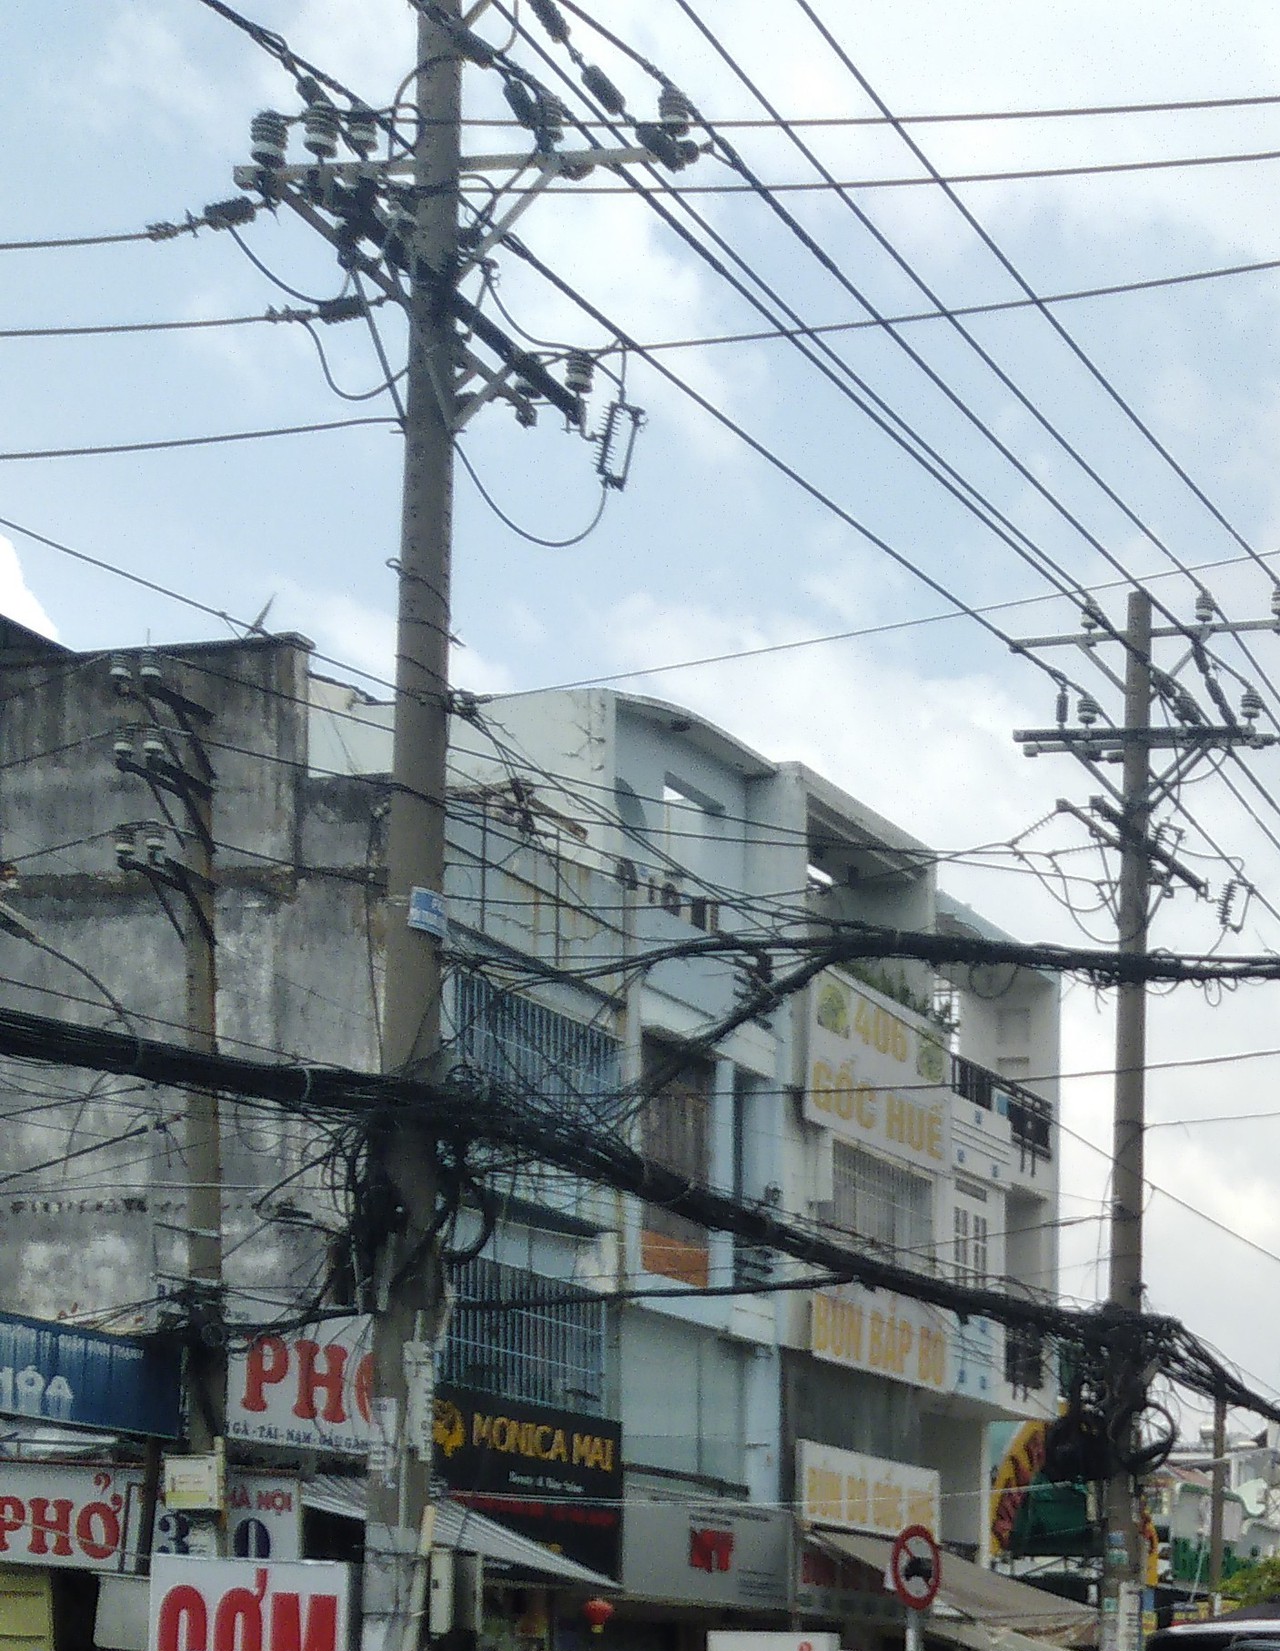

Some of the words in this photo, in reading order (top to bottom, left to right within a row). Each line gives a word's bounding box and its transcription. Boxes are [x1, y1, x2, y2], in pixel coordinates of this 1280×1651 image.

[472, 1412, 569, 1464] MONICA
[572, 1432, 614, 1473] MAI
[0, 1472, 123, 1560] PHỞ
